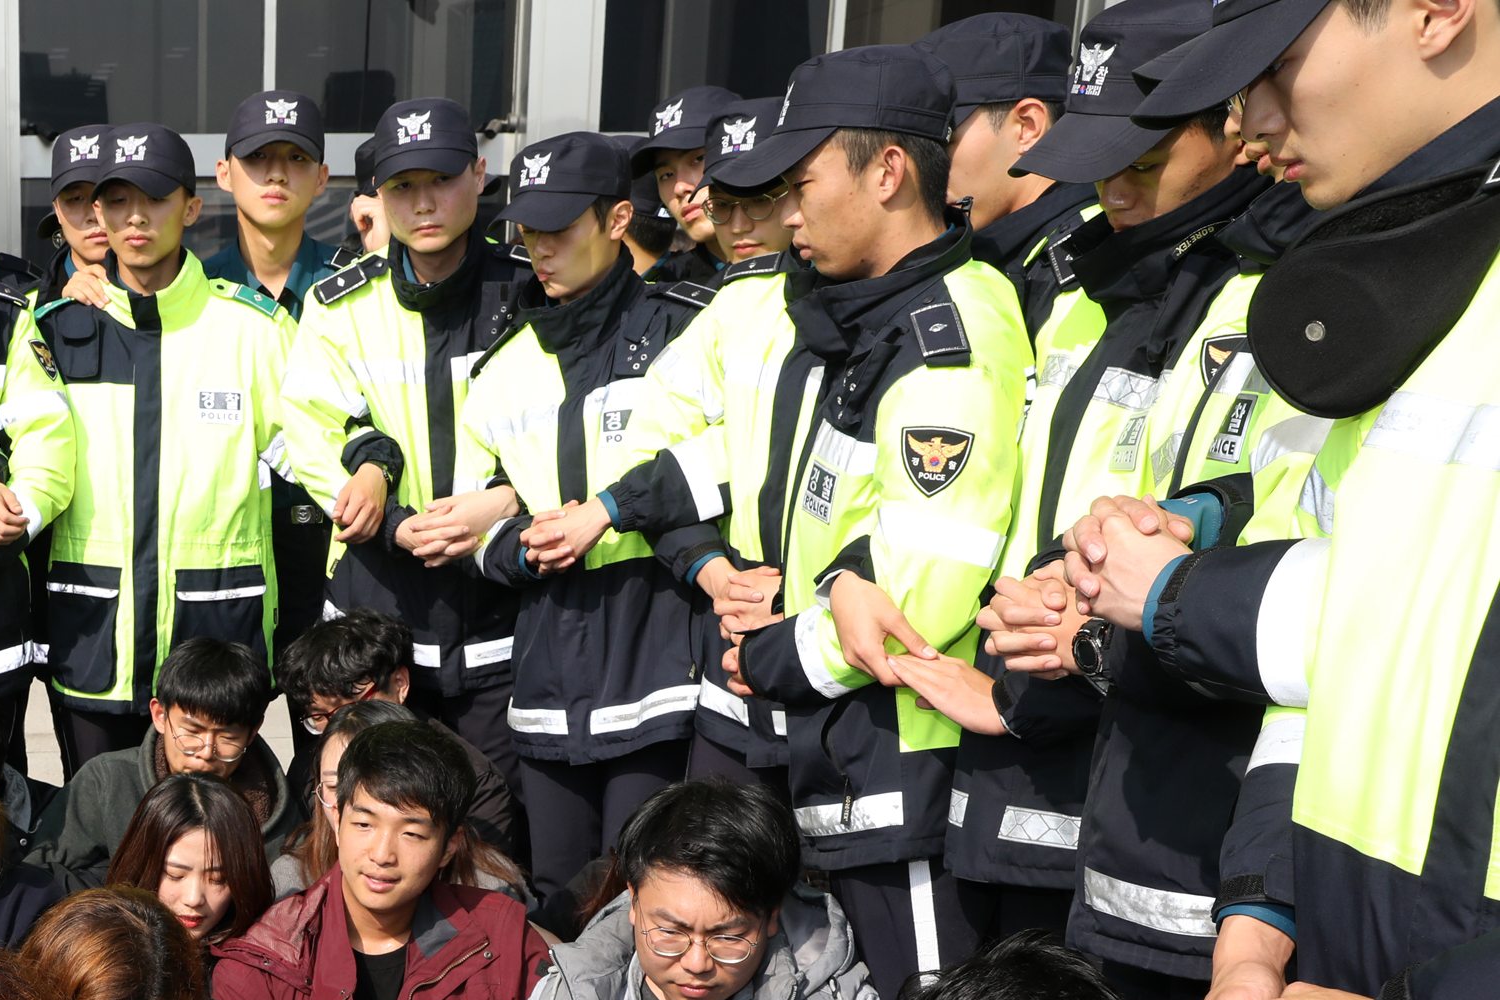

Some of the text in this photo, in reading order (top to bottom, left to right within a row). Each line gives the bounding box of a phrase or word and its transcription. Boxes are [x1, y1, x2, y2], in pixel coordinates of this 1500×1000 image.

[201, 412, 239, 421] POLICE
[918, 472, 945, 482] POLICE
[804, 497, 828, 519] POLICE
